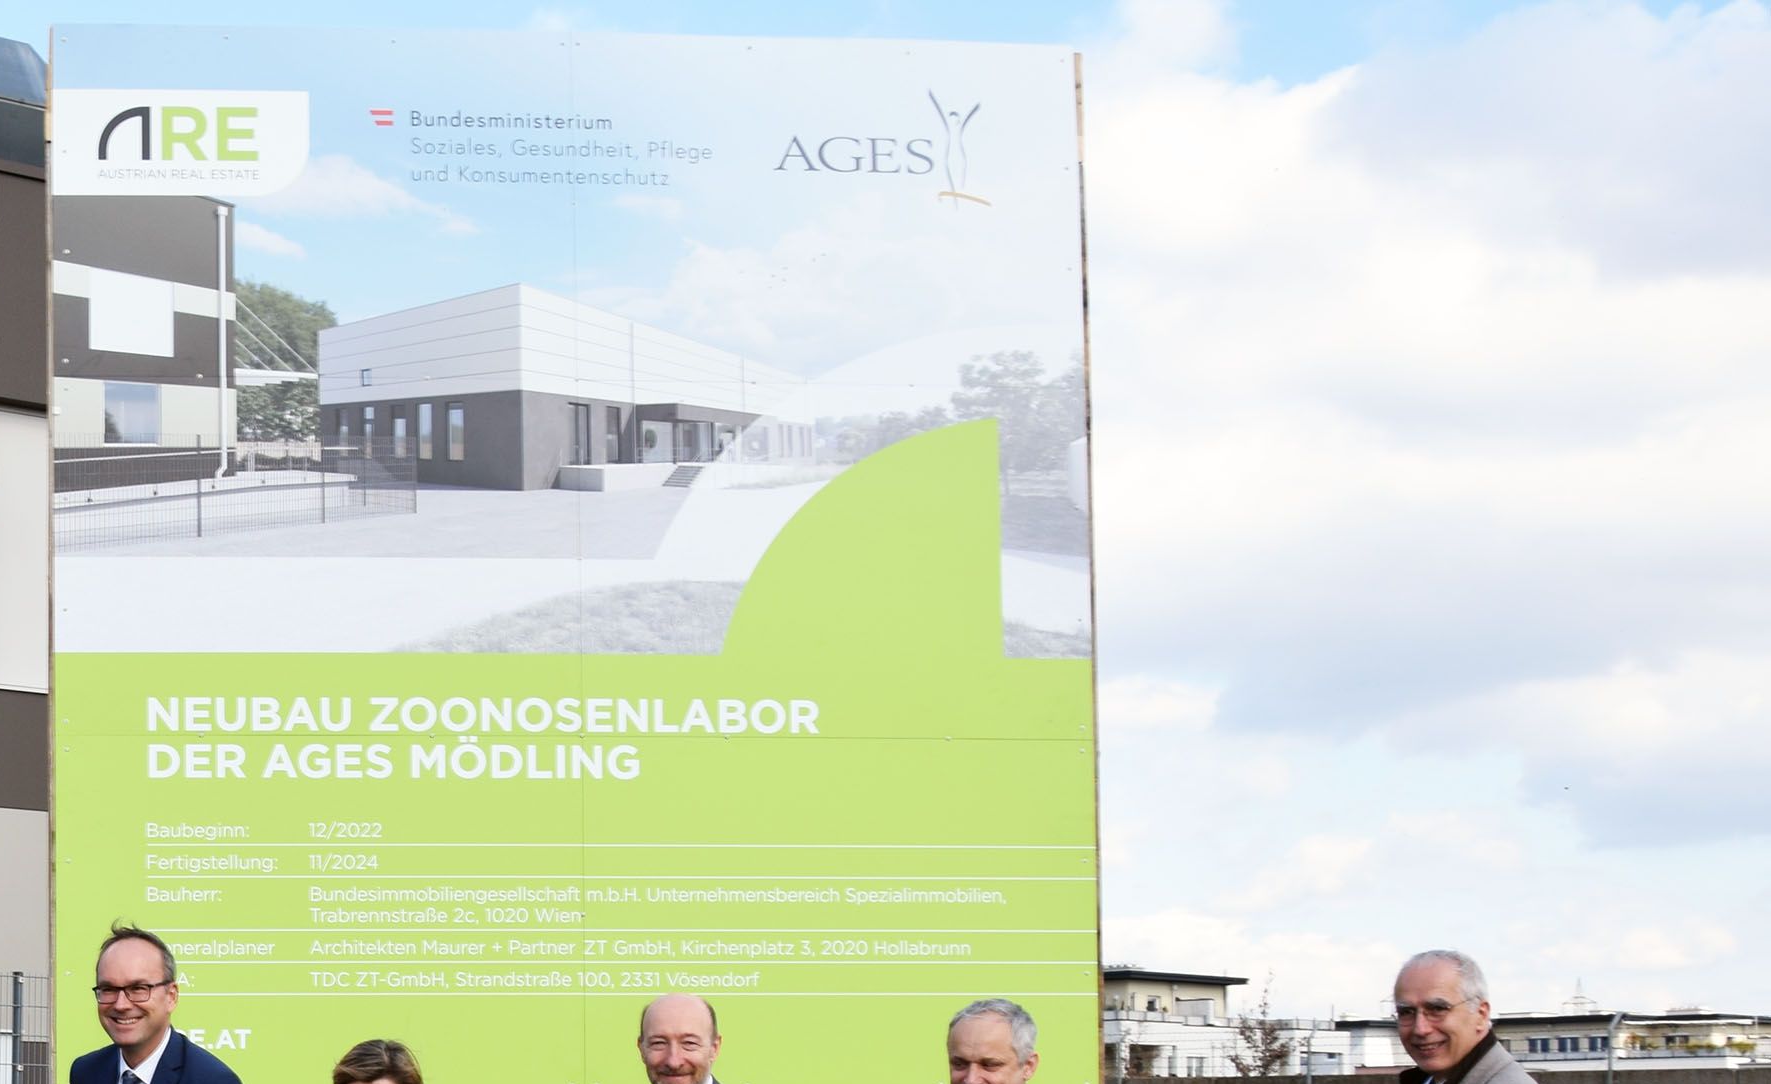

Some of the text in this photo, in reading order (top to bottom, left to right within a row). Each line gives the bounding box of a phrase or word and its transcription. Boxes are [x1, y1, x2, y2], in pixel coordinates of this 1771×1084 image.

[410, 109, 613, 131] Bundesministerium
[96, 104, 261, 162] ARE
[411, 137, 714, 165] Soziales, Gesundheit, Pflege
[773, 135, 934, 175] AGES
[99, 168, 260, 181] AUSTRIAN REAL ESTATE
[411, 165, 670, 187] und Konsumentenschutz
[146, 696, 820, 734] NEUBAU ZOONOSENLABOR
[147, 735, 641, 780] DER AGES MÖDLING
[146, 821, 383, 840] Baubeginn: 12/2022
[146, 853, 379, 872] Fertigstellung: 11/2024
[146, 885, 1007, 906] Bauherr: Bundesimmobiliengesellschaft m.b.H. Unternehmensbereich Spezialimmobilien,
[309, 906, 582, 925] Trabrennstraße 2c, 1020 Wien
[169, 939, 276, 957] neralplaner
[309, 939, 417, 956] Architekten
[421, 939, 487, 956] Maurer
[507, 939, 577, 956] Partner
[583, 939, 609, 956] ZT
[612, 939, 676, 957] GmbH,
[680, 939, 796, 959] Kirchenplatz
[800, 939, 816, 957] 3,
[820, 939, 869, 956] 2020
[873, 939, 972, 956] Hollabrunn
[309, 971, 351, 988] TDC
[355, 971, 450, 989] ZT-GmbH,
[455, 970, 573, 988] Strandstraße
[576, 971, 615, 989] 100,
[620, 971, 661, 988] 2331
[665, 971, 760, 988] Vösendorf
[176, 1029, 252, 1050] E.AT
